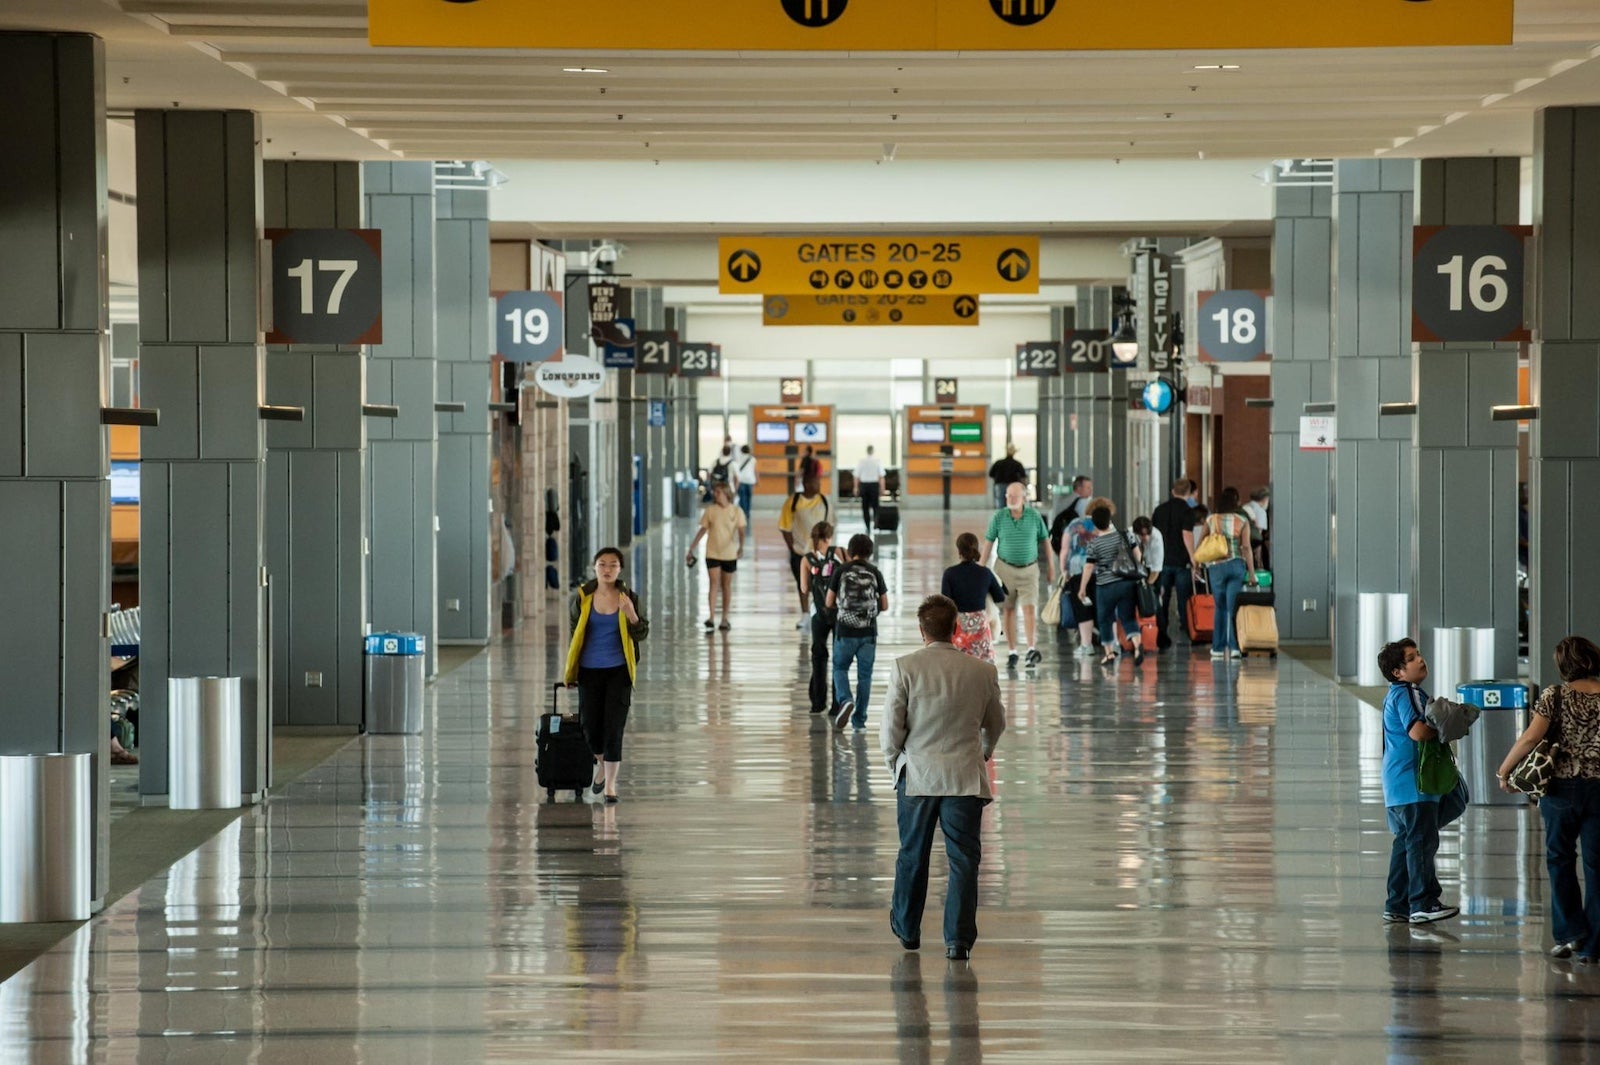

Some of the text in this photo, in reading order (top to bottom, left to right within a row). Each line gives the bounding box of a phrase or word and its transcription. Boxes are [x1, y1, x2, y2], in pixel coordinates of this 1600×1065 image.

[797, 243, 961, 263] GATES 20-25
[287, 258, 359, 315] 17
[1437, 255, 1508, 312] 16
[815, 294, 869, 305] GATES
[504, 307, 550, 345] 19
[1211, 307, 1257, 345] 18
[642, 341, 670, 364] 21
[682, 349, 708, 370] 23
[1030, 349, 1057, 369] 22
[1071, 340, 1102, 362] 20
[937, 380, 956, 395] 24
